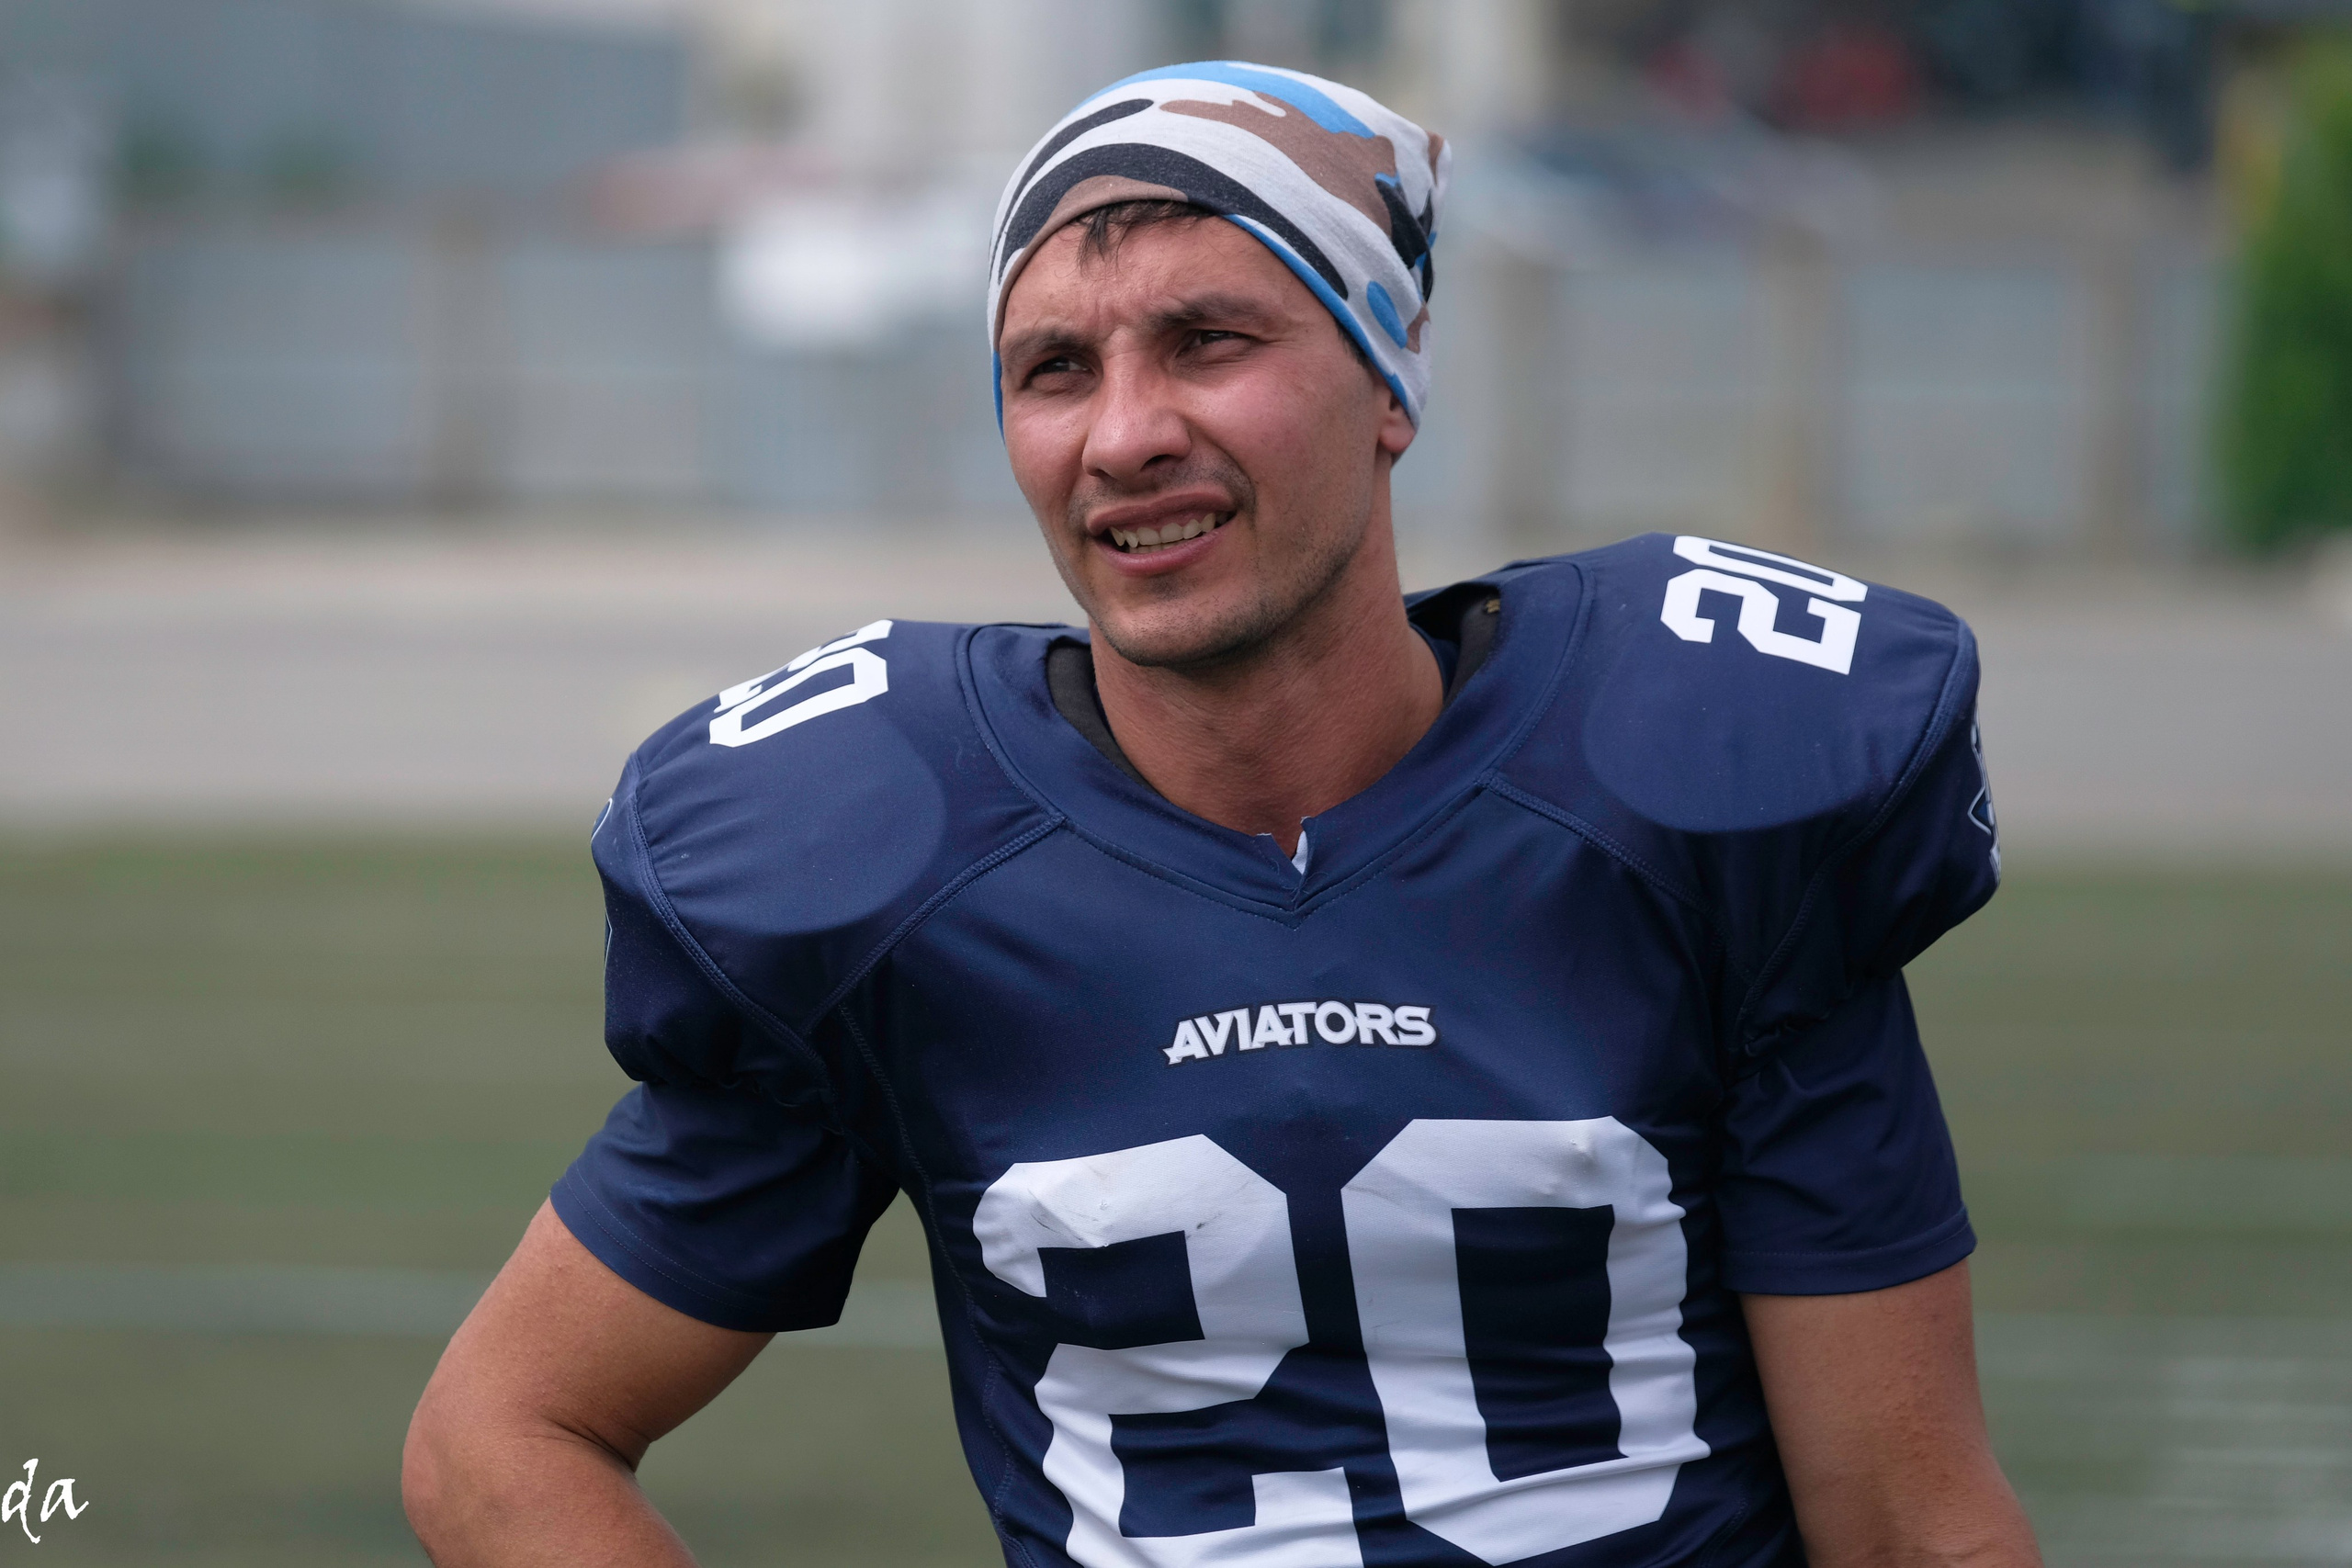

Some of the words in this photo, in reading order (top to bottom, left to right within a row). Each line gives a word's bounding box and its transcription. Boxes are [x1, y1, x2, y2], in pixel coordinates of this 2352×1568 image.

[1660, 536, 1868, 675] 20
[1162, 1000, 1437, 1066] AVIATORS
[972, 1115, 1712, 1568] 20
